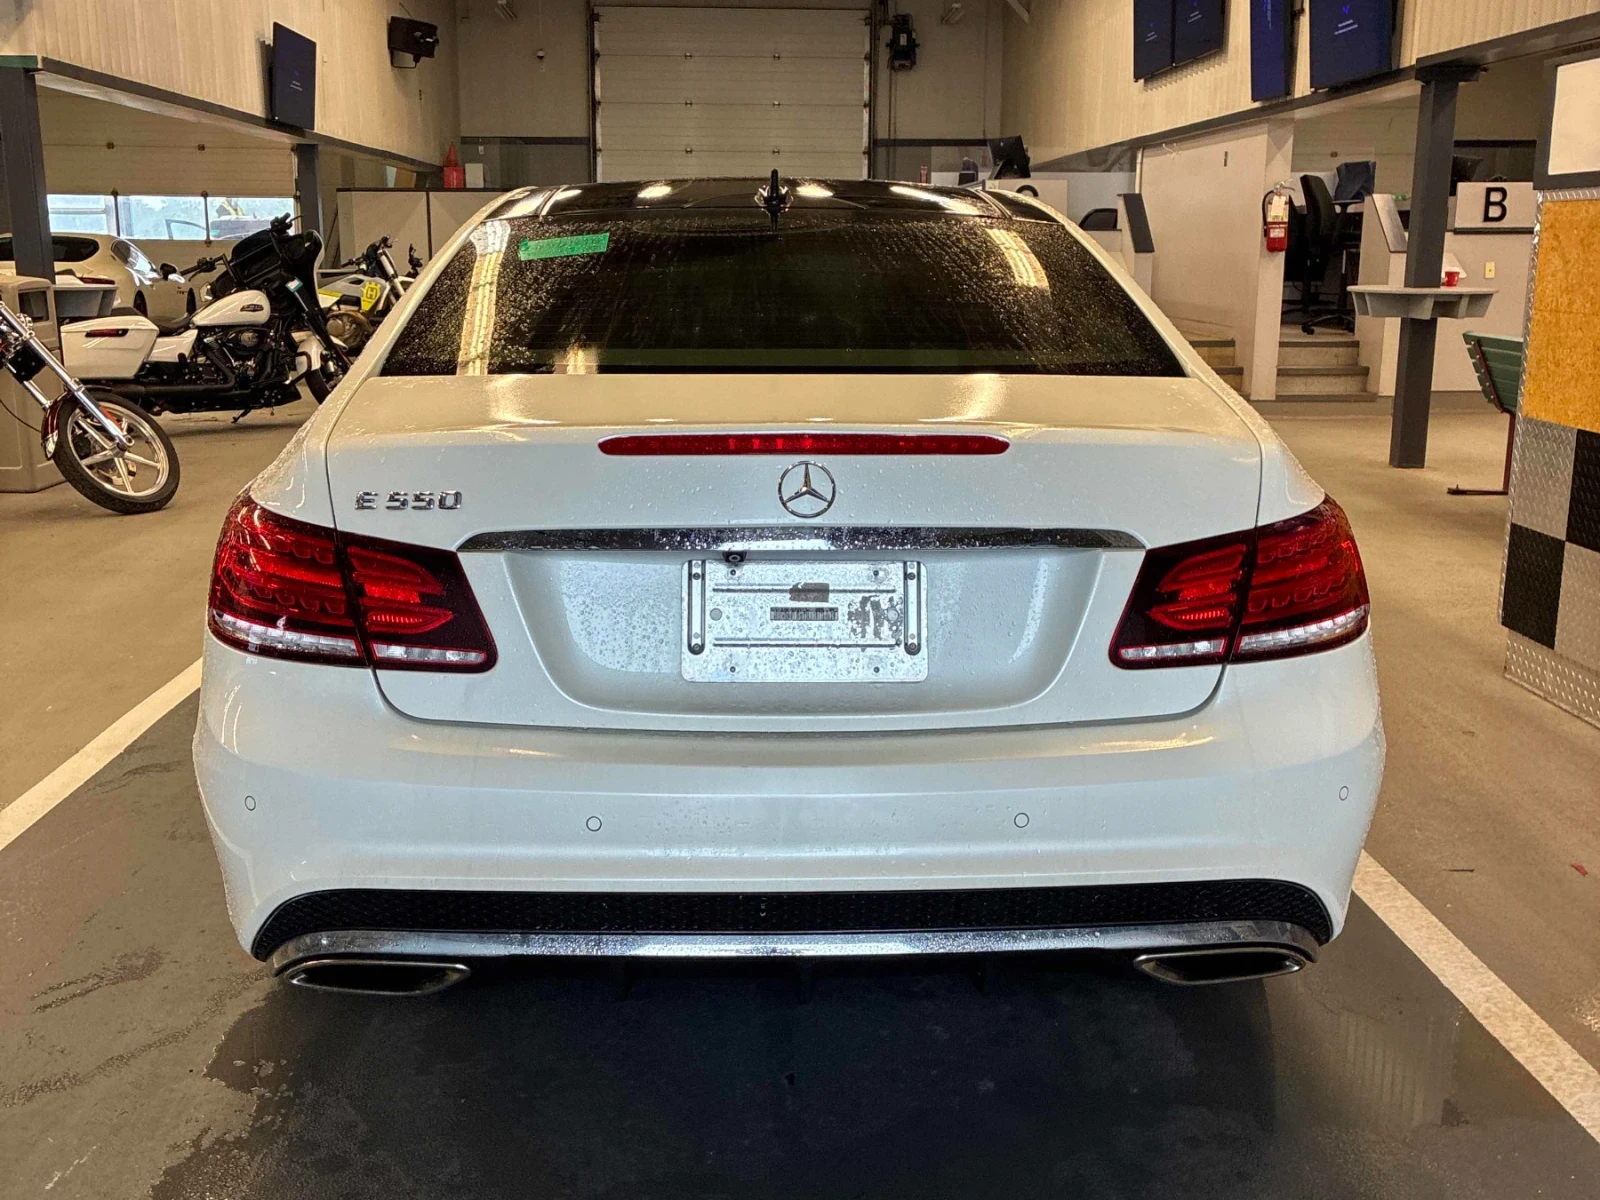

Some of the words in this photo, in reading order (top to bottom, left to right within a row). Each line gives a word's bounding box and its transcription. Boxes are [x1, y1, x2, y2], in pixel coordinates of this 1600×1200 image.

[1483, 187, 1508, 222] B
[355, 491, 378, 510] E
[385, 491, 463, 510] 550
